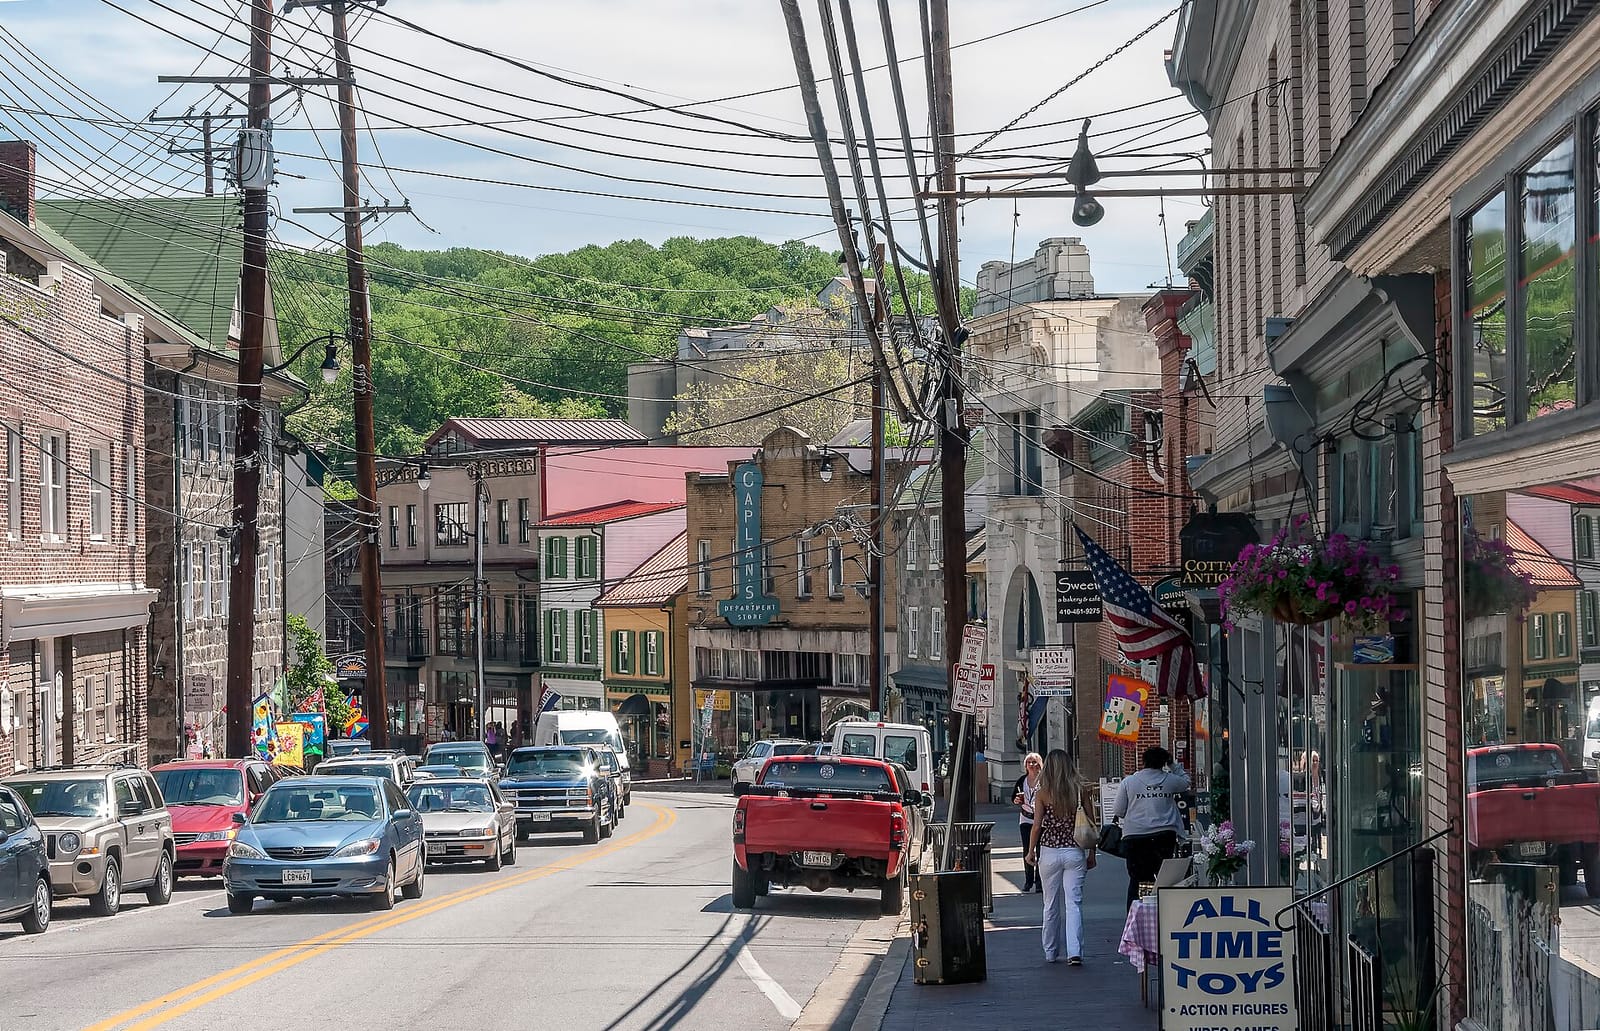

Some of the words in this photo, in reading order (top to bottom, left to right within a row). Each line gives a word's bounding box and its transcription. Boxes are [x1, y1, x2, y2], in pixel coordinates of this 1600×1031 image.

[1184, 559, 1233, 572] COTTA
[724, 604, 776, 612] DEPARTMENT
[737, 613, 762, 621] STORE
[958, 669, 969, 680] 30
[980, 668, 993, 677] OW
[1183, 896, 1270, 929] ALL
[1171, 931, 1283, 959] TIME
[1171, 961, 1285, 995] TOYS
[1180, 1004, 1228, 1017] ACTION
[1232, 1003, 1289, 1015] FIGURES
